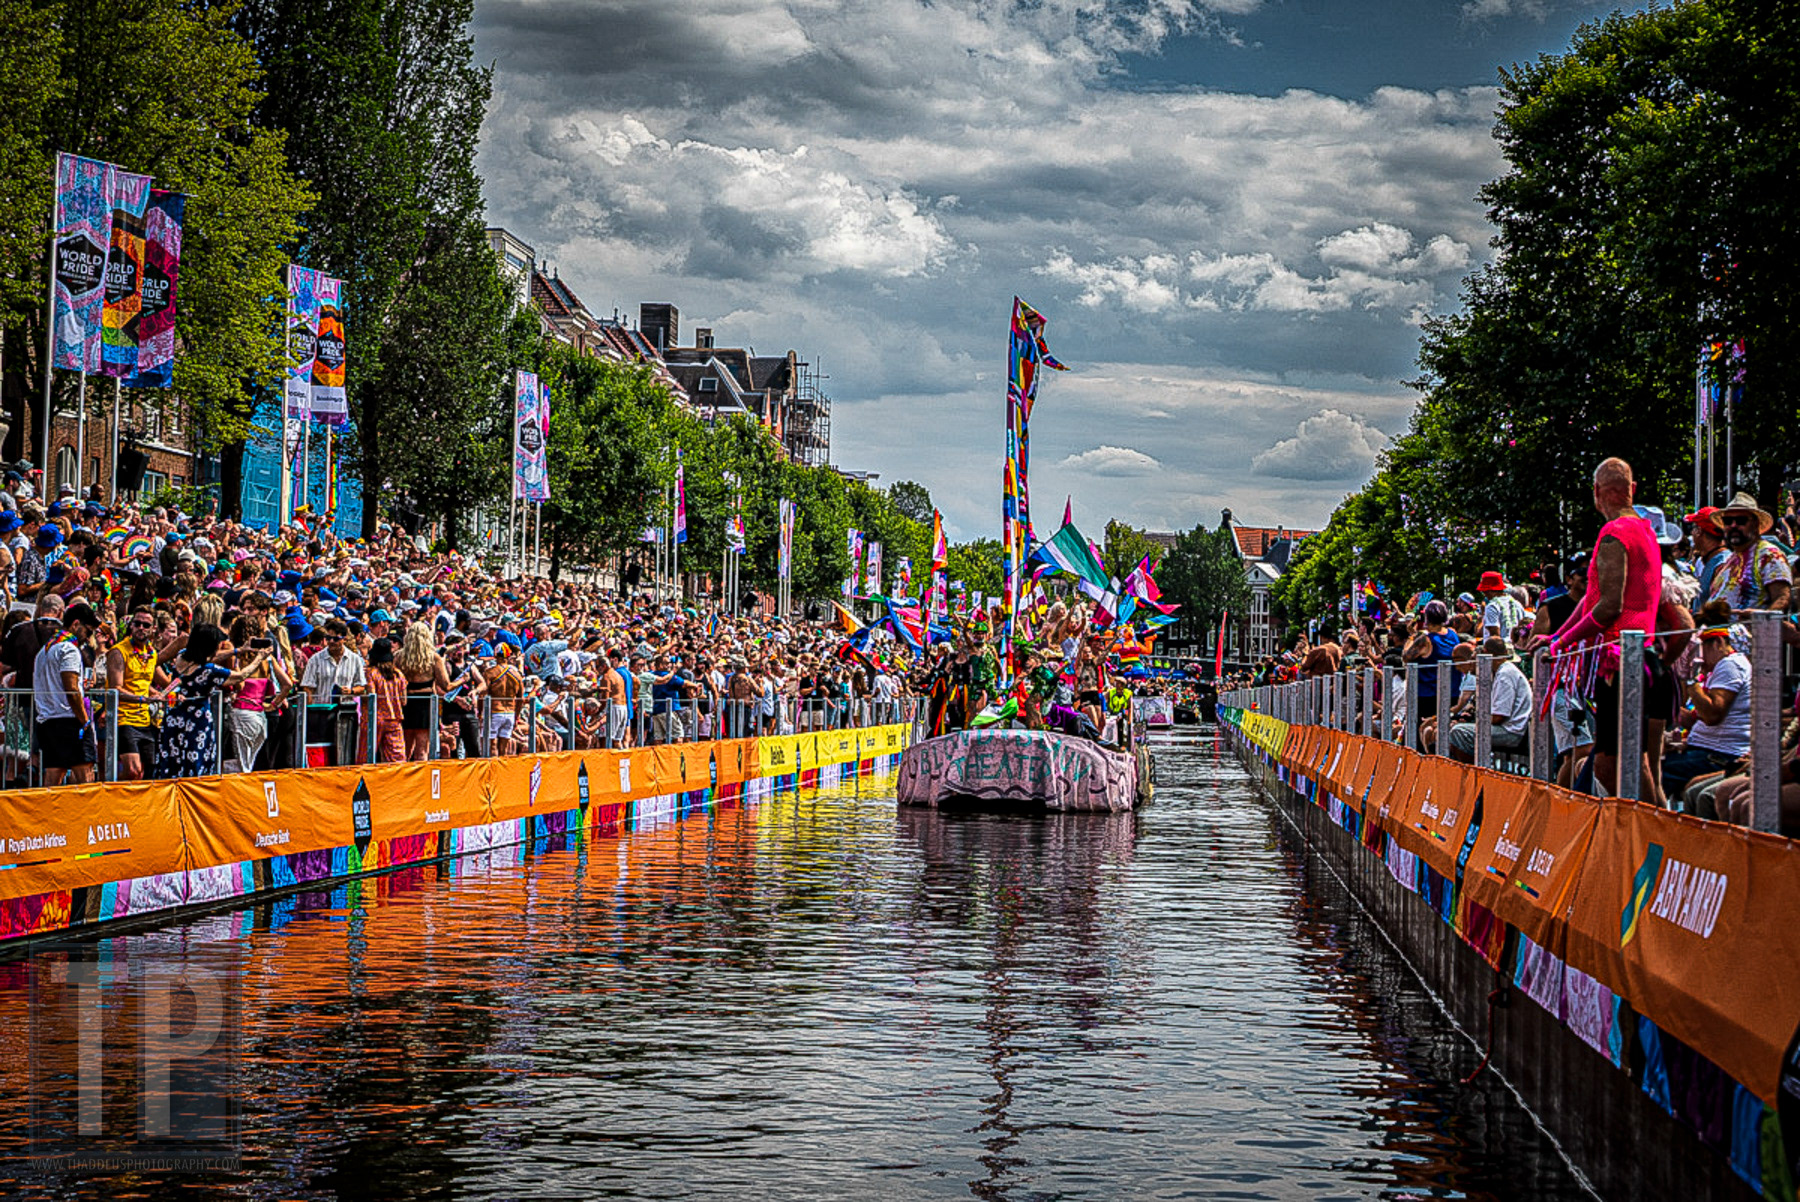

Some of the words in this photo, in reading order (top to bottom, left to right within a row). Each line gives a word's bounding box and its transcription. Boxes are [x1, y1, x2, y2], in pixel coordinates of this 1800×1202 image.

[60, 247, 103, 266] WORLD
[62, 260, 96, 276] PRIDE
[106, 262, 135, 275] ORLD
[105, 273, 129, 285] RIDE
[951, 749, 1051, 784] THEATER
[97, 823, 130, 841] DELTA
